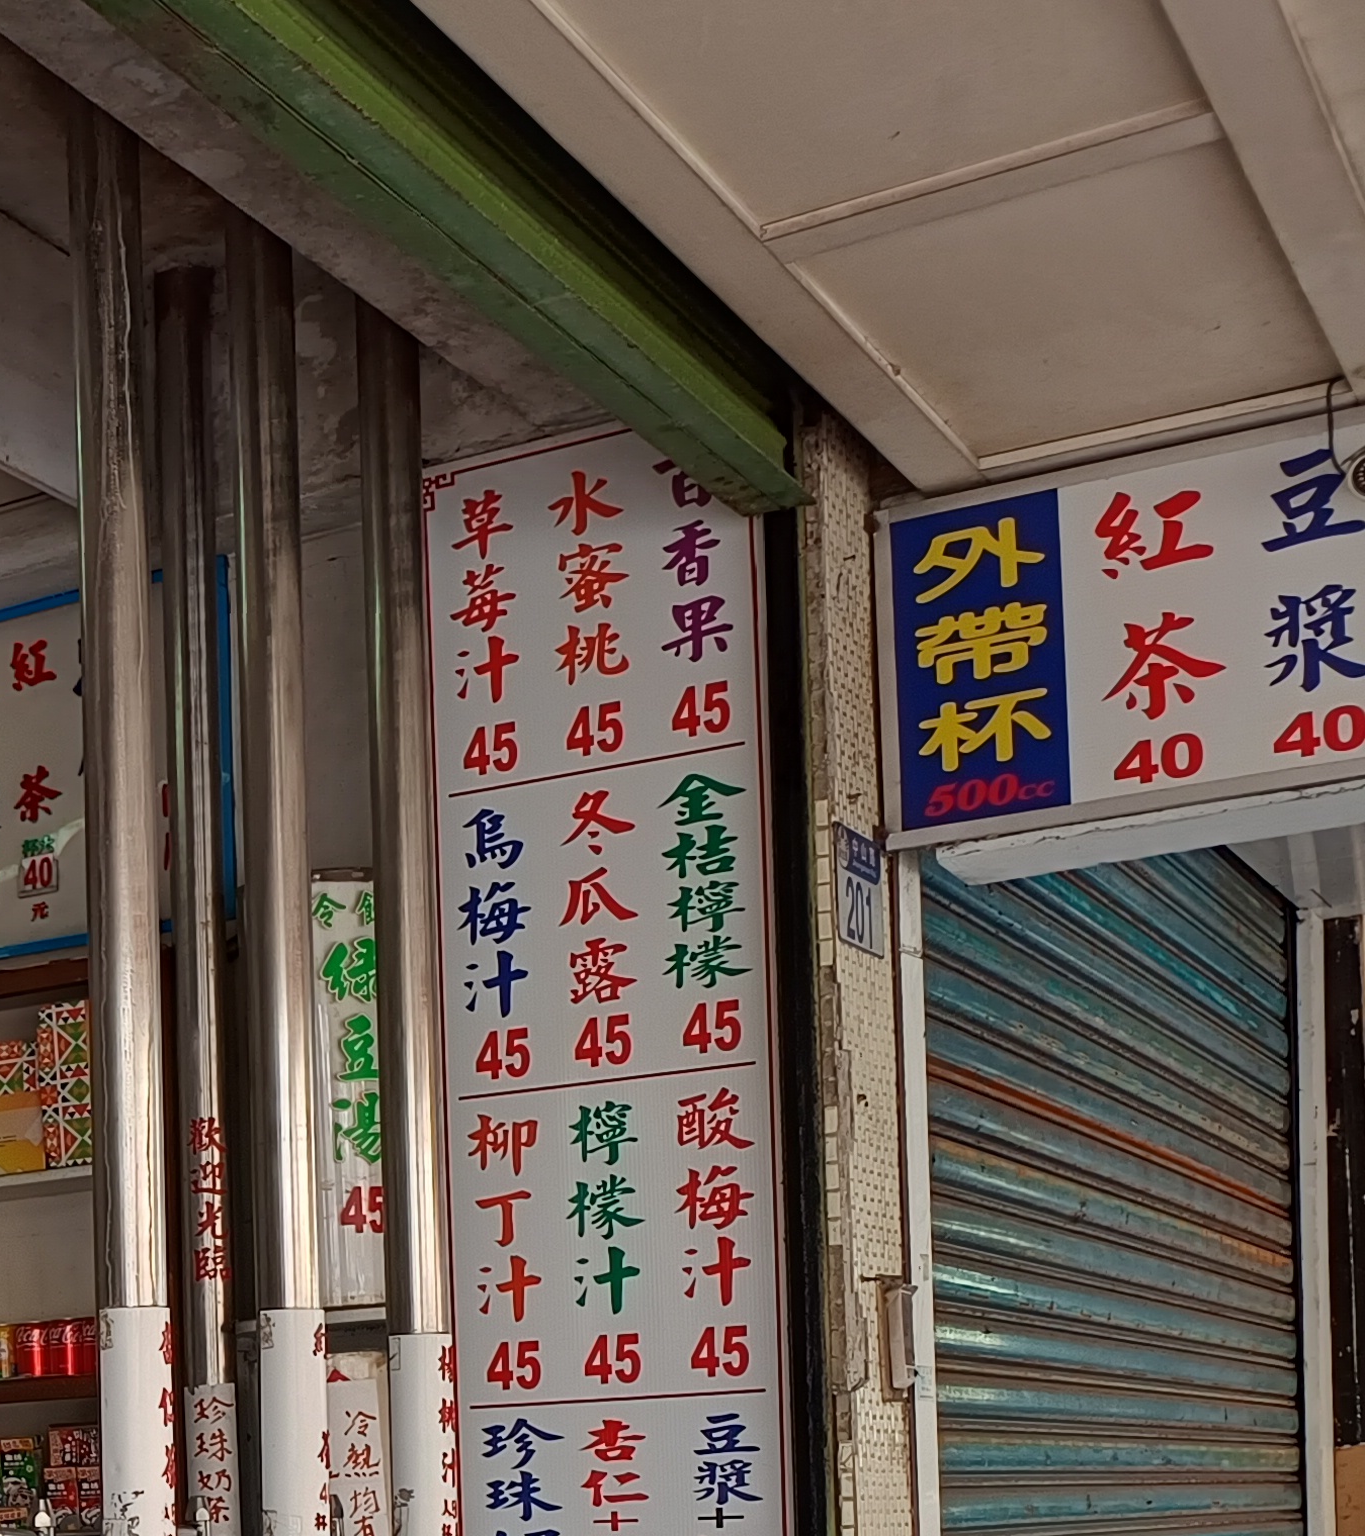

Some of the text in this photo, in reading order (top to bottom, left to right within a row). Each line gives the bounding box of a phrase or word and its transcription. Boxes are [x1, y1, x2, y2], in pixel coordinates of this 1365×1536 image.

[10, 639, 63, 824] 紅茶
[451, 489, 520, 776] 草莓汁 45
[548, 470, 631, 757] 水蜜桃 45
[653, 455, 734, 737] 百香果 45
[912, 516, 1055, 818] 外帶杯 500cc
[1094, 490, 1227, 784] 紅茶 40
[1261, 447, 1365, 758] 豆漿 40
[24, 856, 53, 891] 40
[457, 808, 532, 1080] 烏梅汁 45
[558, 789, 638, 1068] 冬瓜露 45
[657, 773, 753, 1055] 金桔檸檬 45
[846, 876, 873, 950] 201
[186, 1116, 232, 1282] 歡迎光臨
[468, 1113, 542, 1390] 柳丁汁 45
[567, 1099, 646, 1385] 檸檬汁 45
[674, 1087, 756, 1378] 酸梅汁 45
[193, 1395, 235, 1524] 珍珠奶茶
